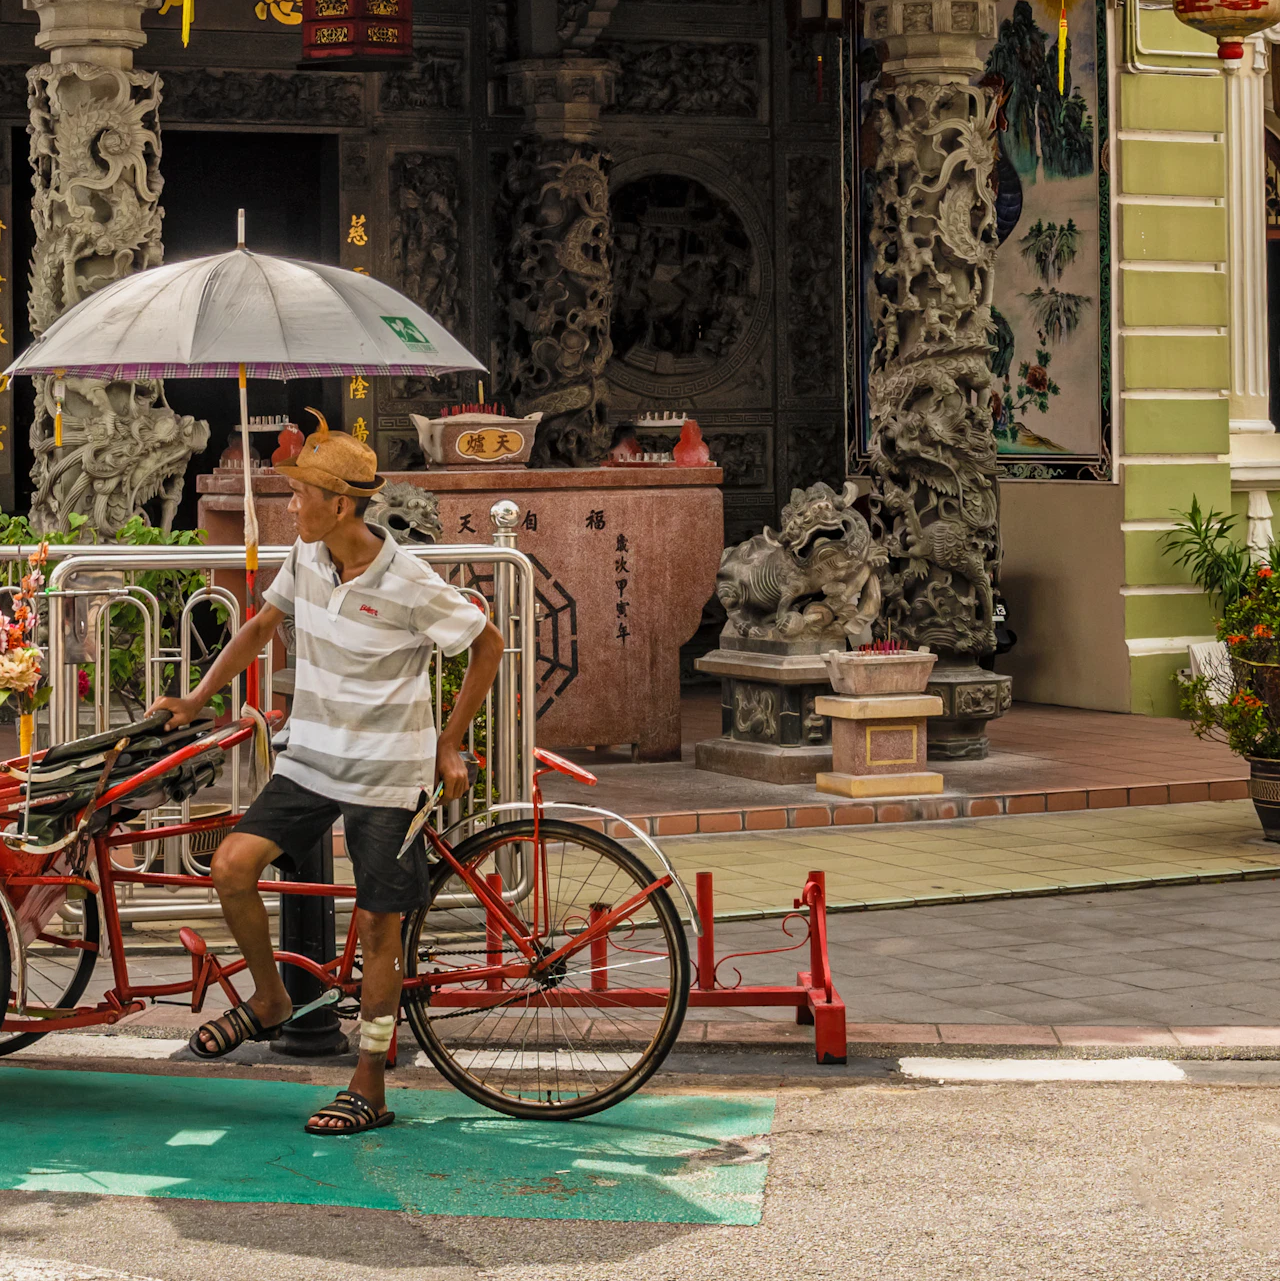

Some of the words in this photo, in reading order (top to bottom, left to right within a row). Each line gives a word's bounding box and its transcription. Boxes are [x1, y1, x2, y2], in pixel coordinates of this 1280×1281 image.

[464, 434, 514, 454] 天爐
[614, 533, 631, 647] 歲次甲寅年
